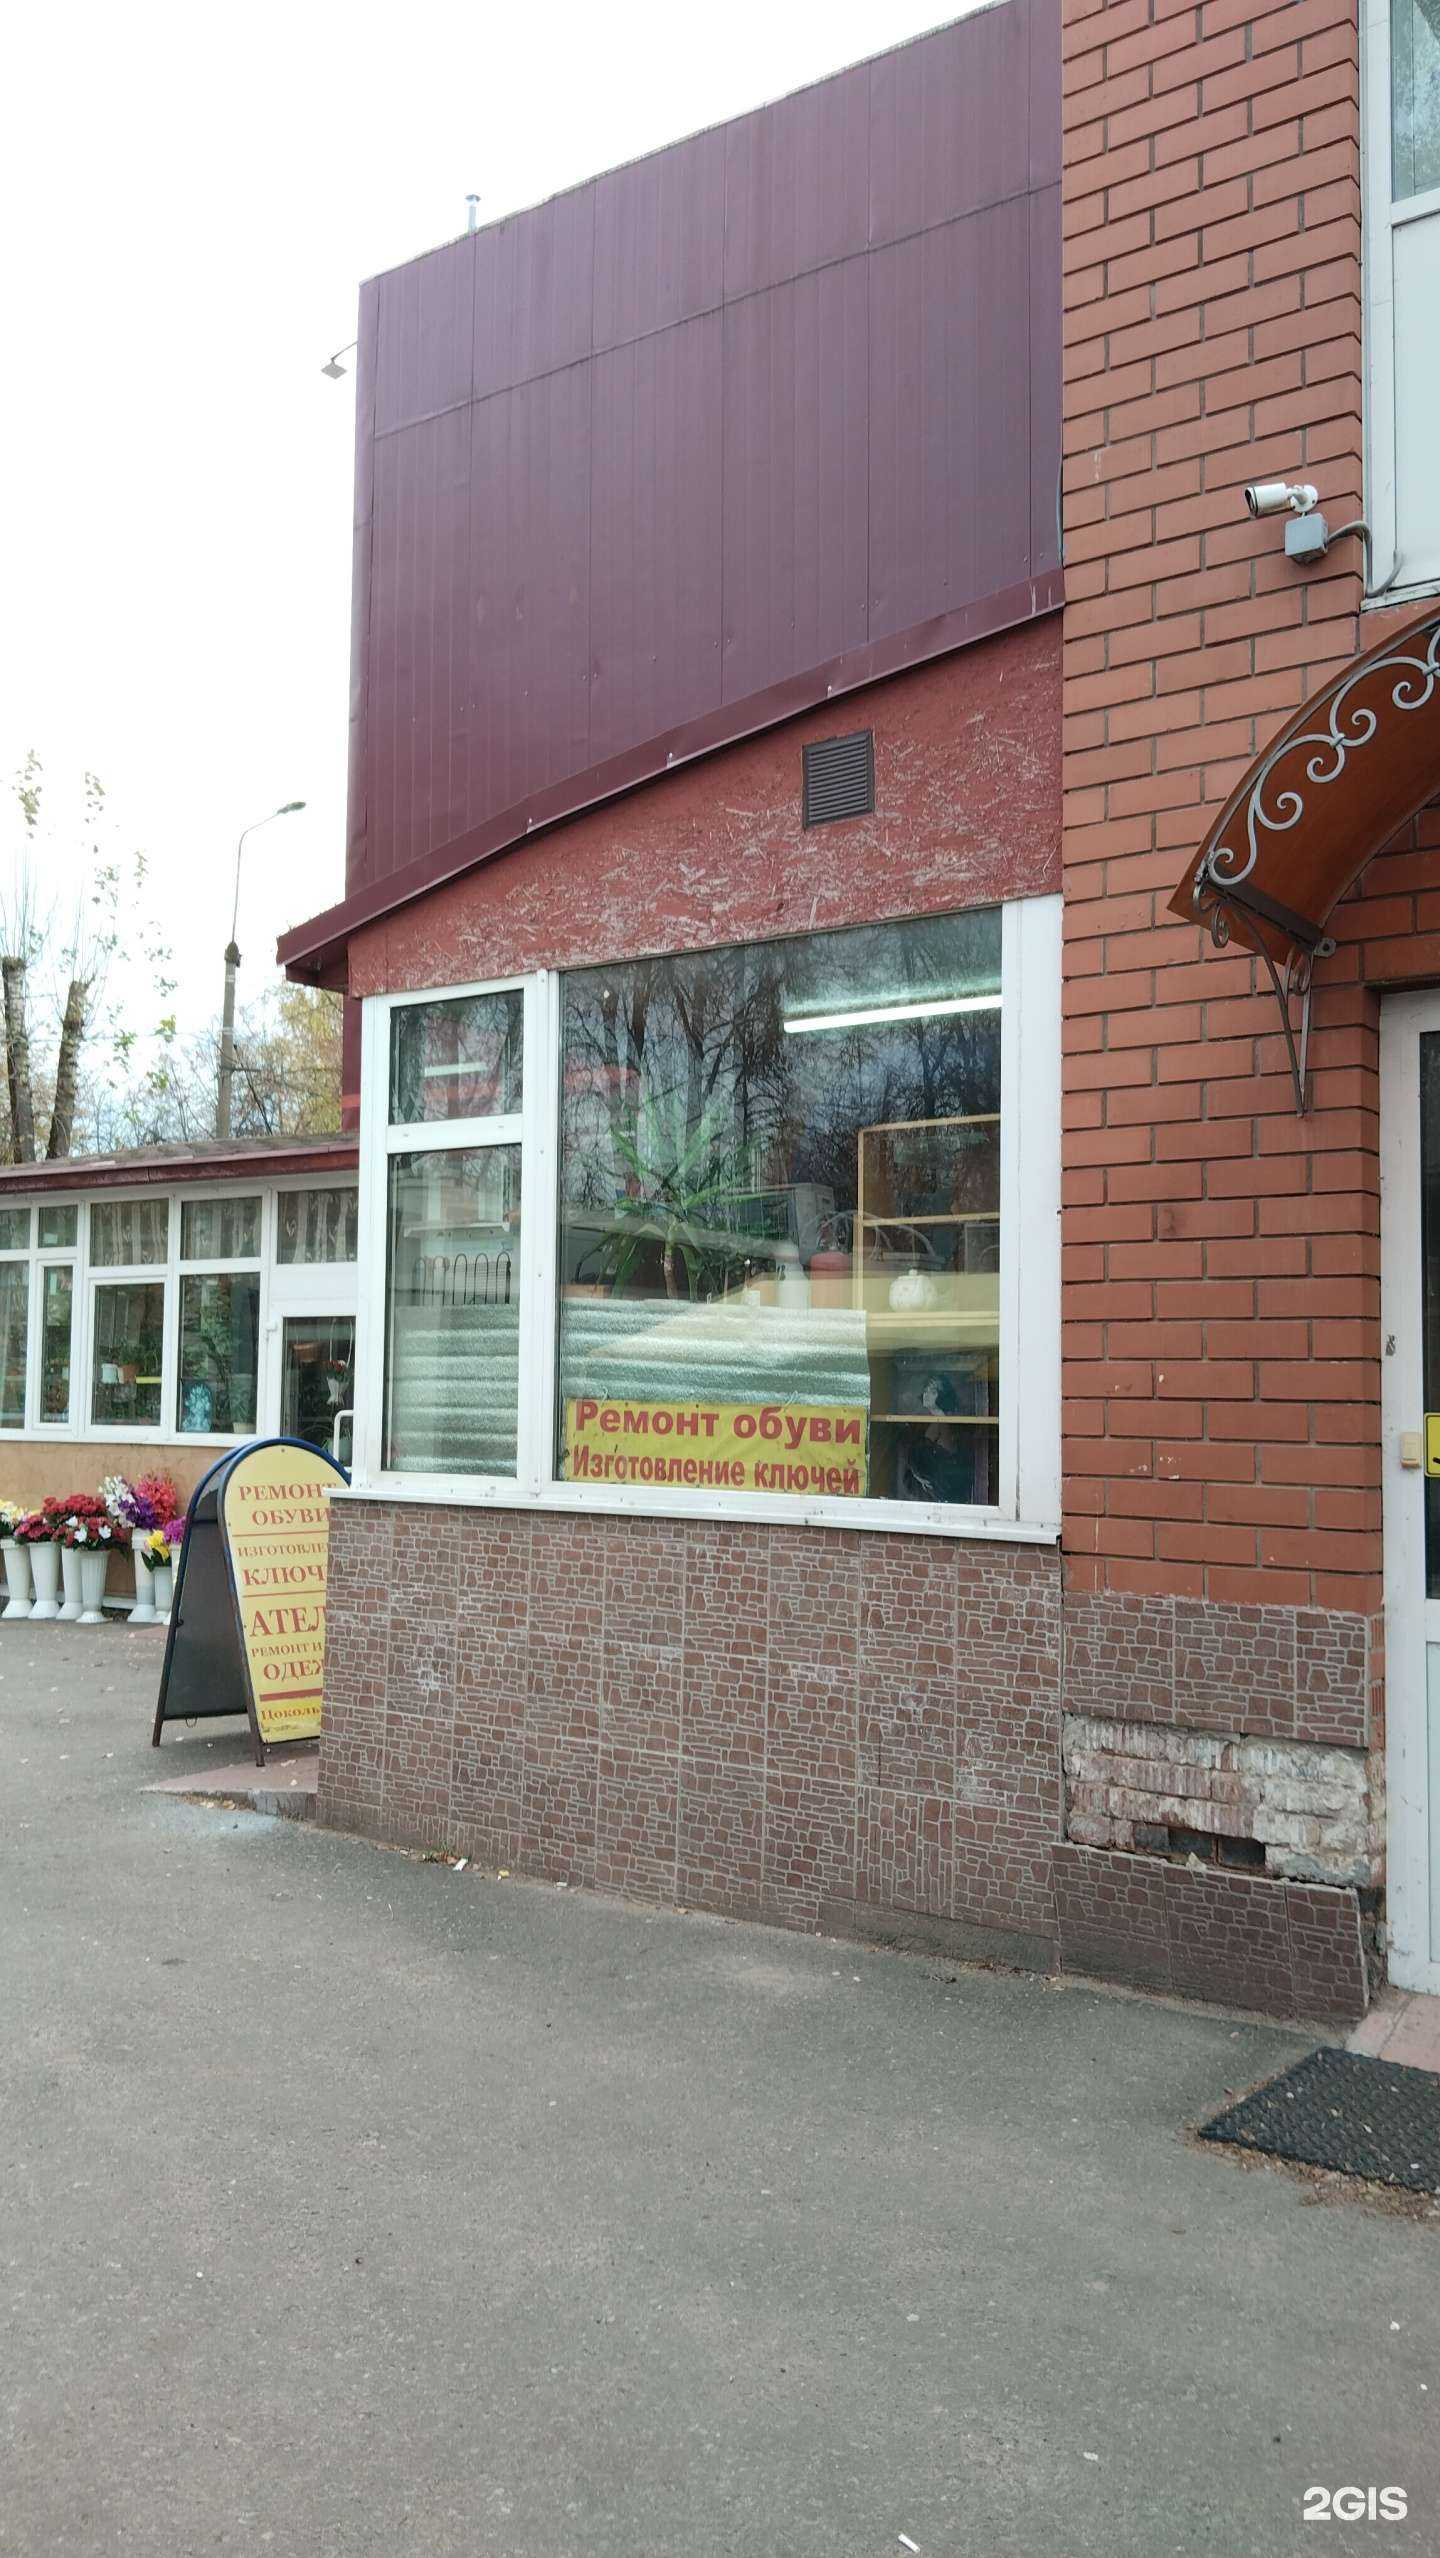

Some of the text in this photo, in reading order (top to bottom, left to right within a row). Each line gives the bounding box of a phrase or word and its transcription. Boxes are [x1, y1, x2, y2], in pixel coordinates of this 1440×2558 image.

[575, 1401, 861, 1450] Ремонт обуви
[573, 1445, 860, 1495] Изготовление ключей
[239, 1483, 336, 1501] РЕМОН
[251, 1643, 309, 1658] РЕМОНТ
